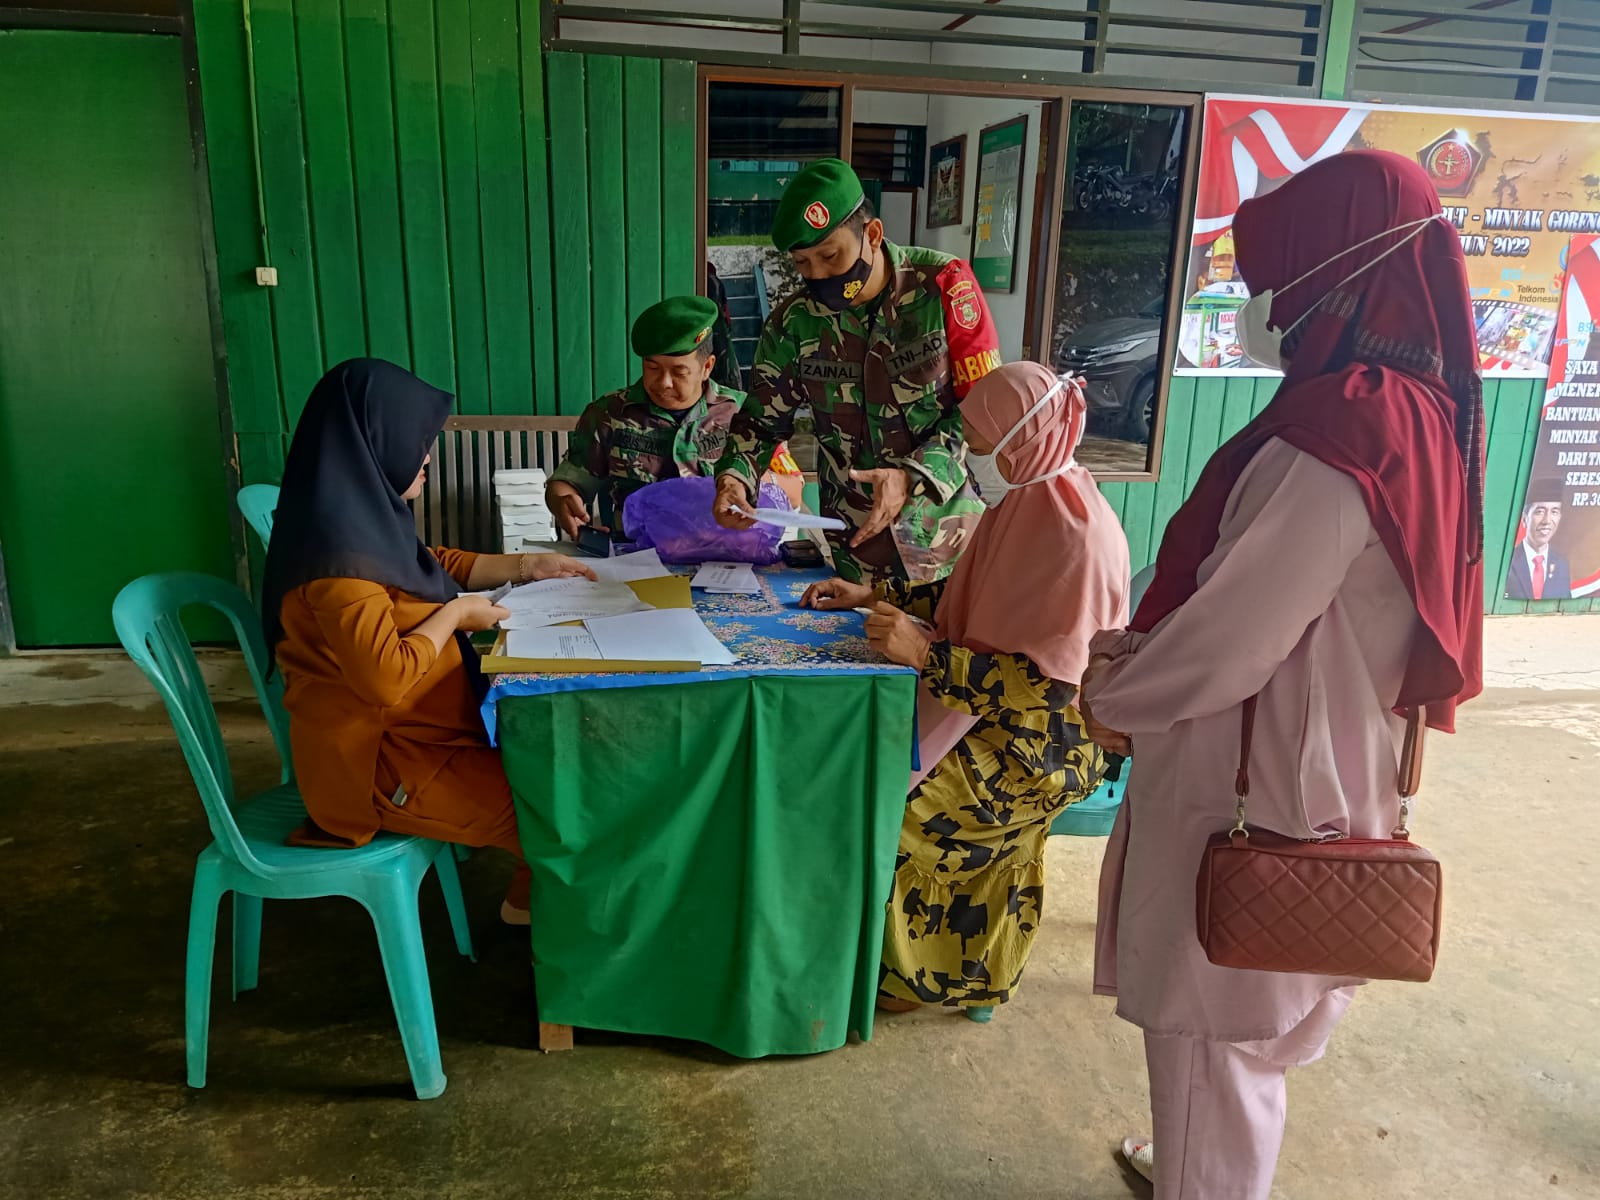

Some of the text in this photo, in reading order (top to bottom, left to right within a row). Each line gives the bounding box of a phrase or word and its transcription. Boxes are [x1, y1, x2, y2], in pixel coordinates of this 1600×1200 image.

[1482, 207, 1544, 231] MINYAK
[1491, 236, 1531, 257] 2022
[1517, 284, 1546, 294] Telkom
[1519, 294, 1559, 304] Indonesia
[888, 337, 943, 371] TNI-AD
[803, 363, 859, 379] ZAINAL
[1565, 360, 1599, 375] SAYA
[1549, 429, 1598, 444] MINYAK
[1557, 451, 1588, 466] DARI
